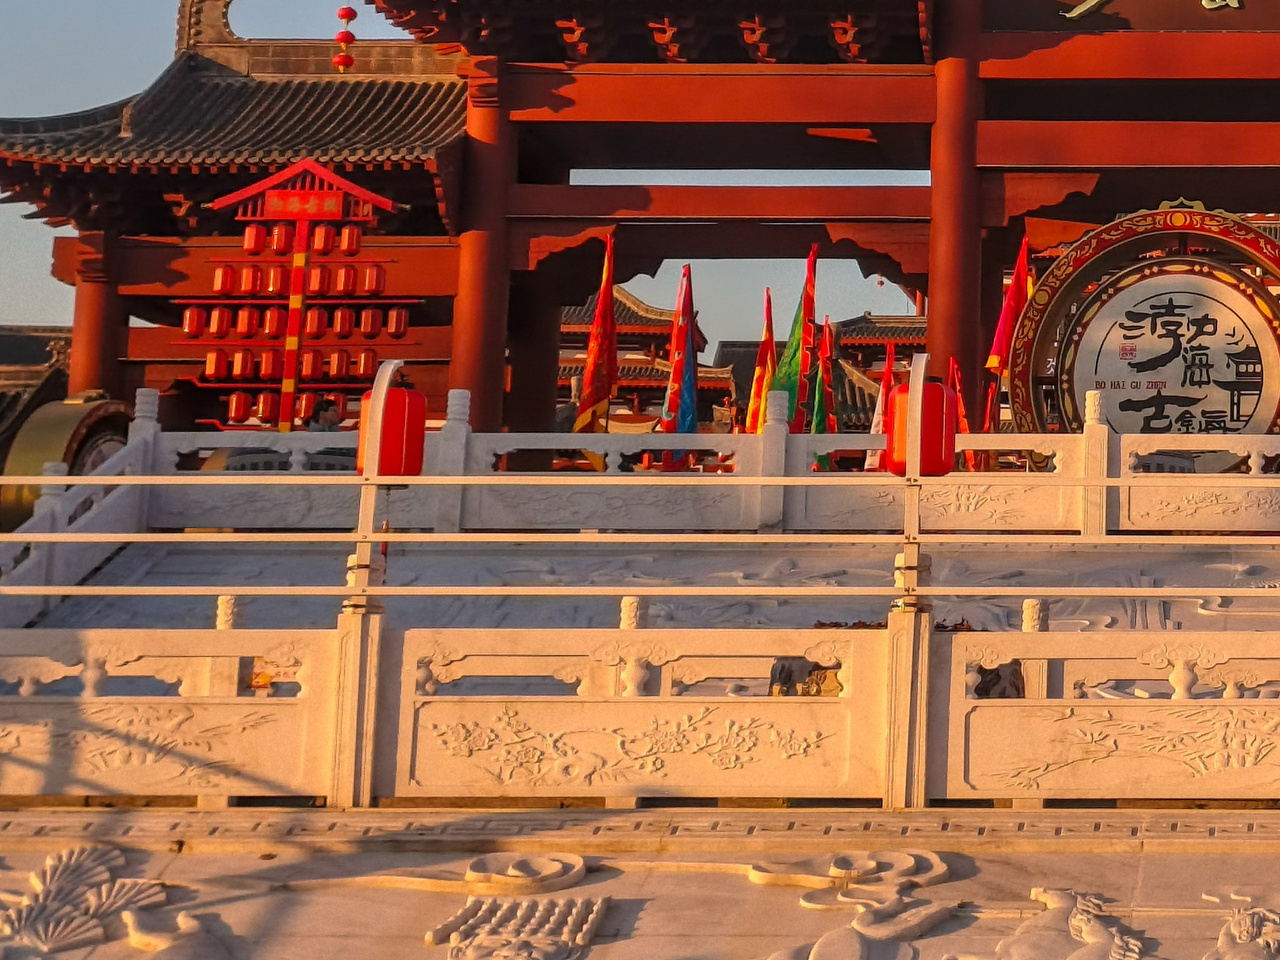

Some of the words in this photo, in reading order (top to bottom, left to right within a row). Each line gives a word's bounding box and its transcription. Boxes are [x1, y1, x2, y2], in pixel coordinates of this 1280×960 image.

[1095, 380, 1106, 390] BO
[1110, 380, 1126, 390] HAI
[1130, 380, 1142, 390] GU
